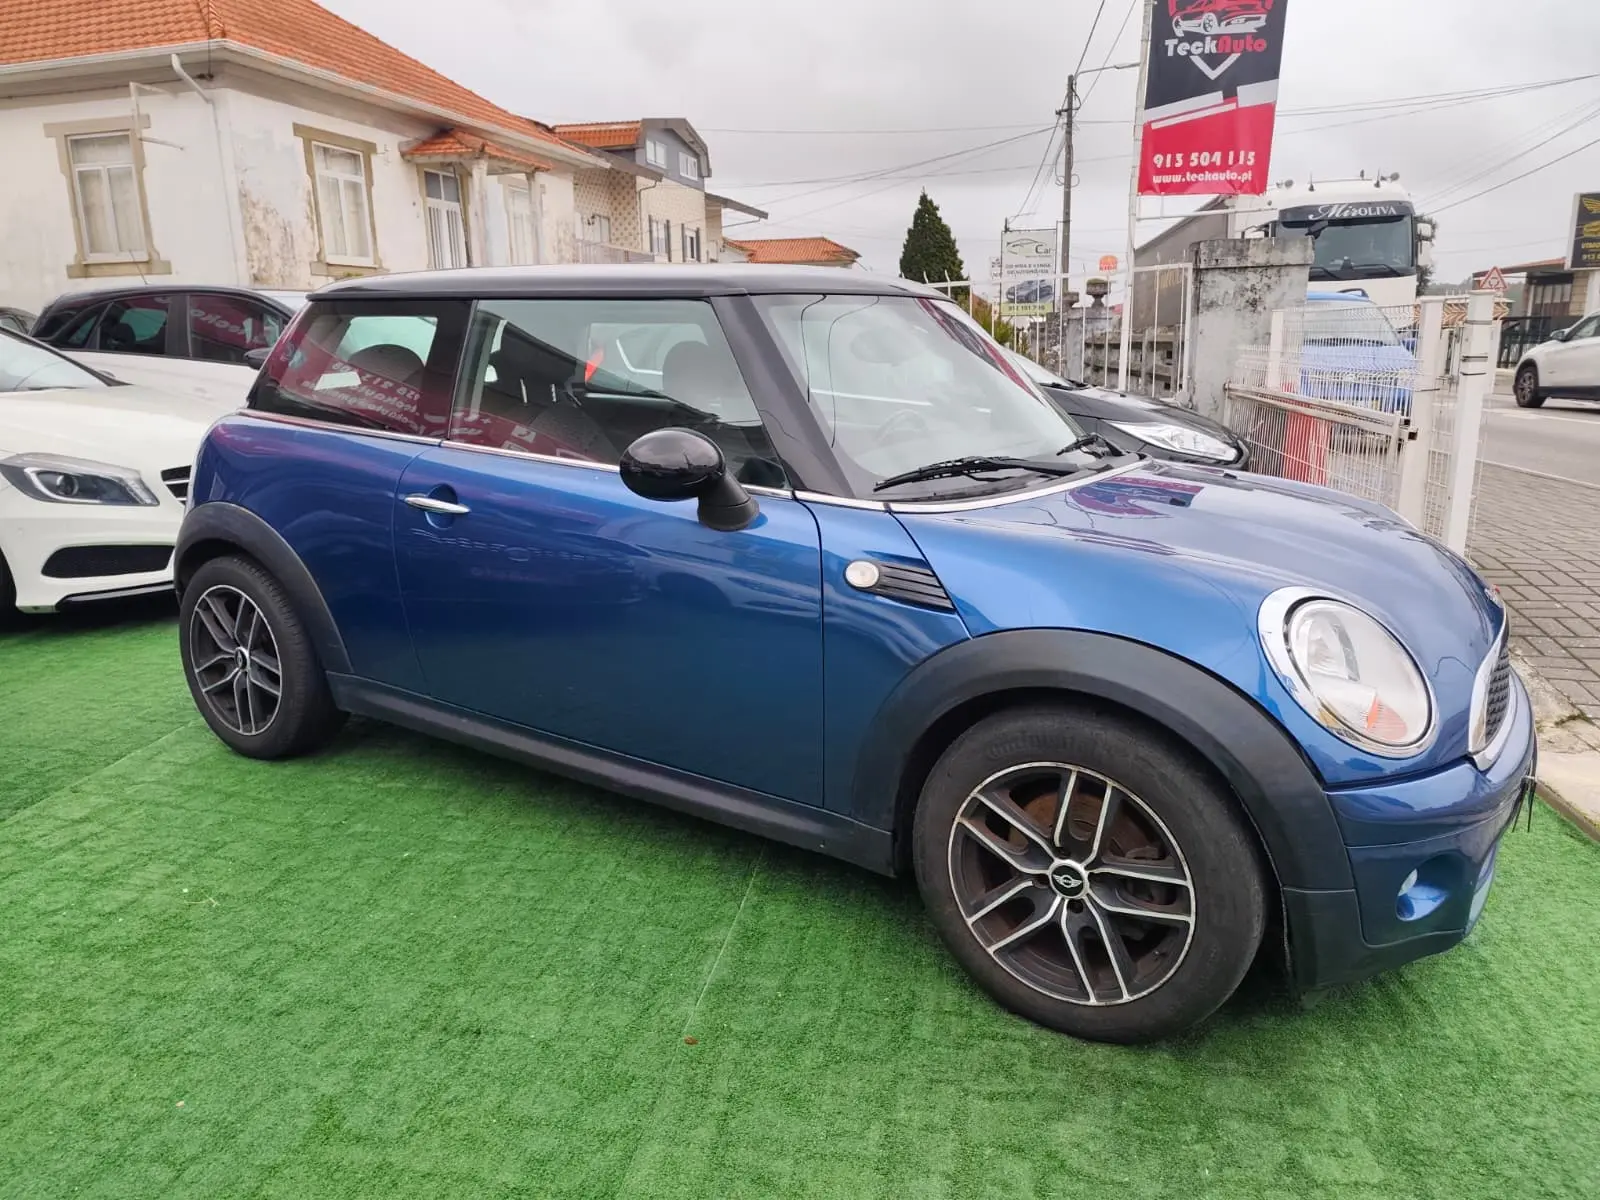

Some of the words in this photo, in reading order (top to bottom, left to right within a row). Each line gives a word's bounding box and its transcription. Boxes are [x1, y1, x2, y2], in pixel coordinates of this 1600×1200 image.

[1165, 36, 1267, 56] TeckAuto
[1190, 151, 1221, 166] 504
[1152, 169, 1252, 184] www.teckauto.pt
